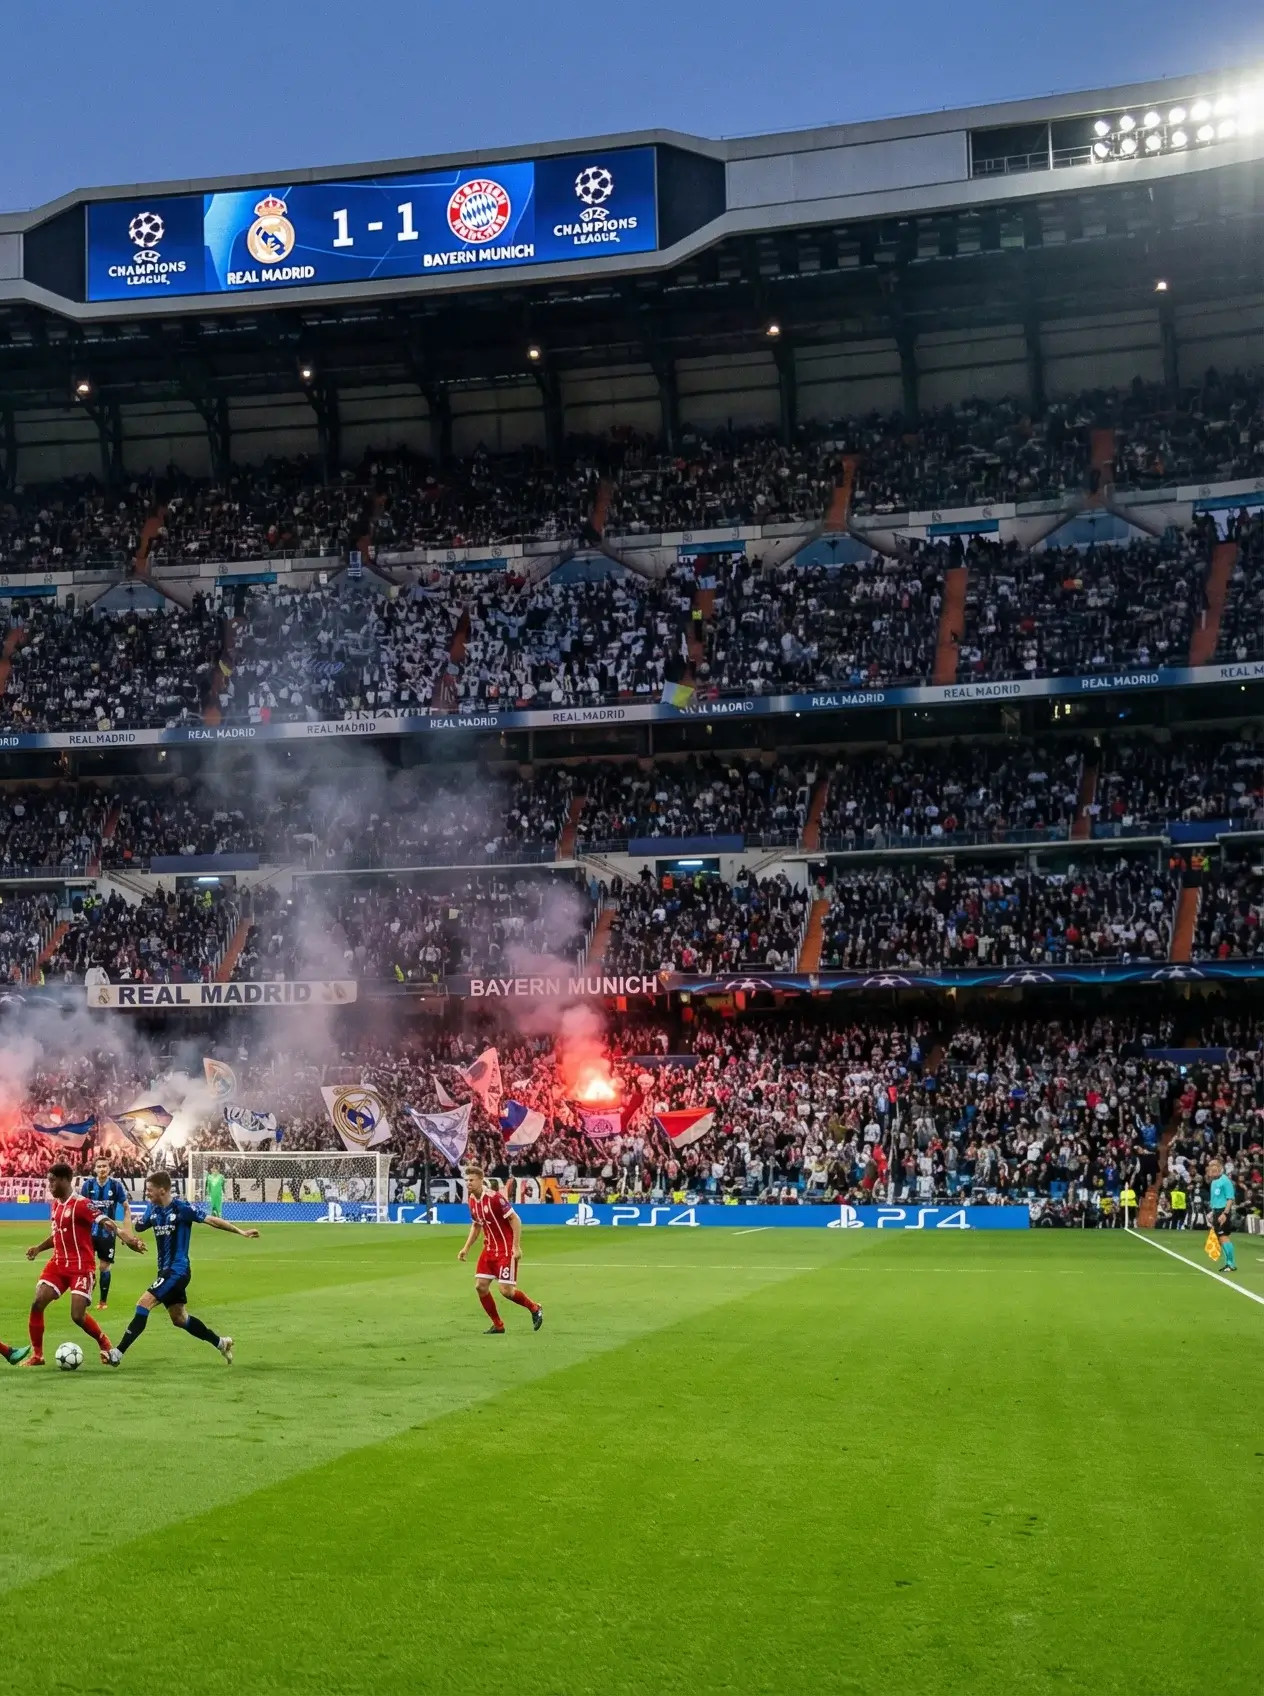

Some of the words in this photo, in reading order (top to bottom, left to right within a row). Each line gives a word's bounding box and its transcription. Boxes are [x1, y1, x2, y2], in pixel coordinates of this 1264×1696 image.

[333, 208, 353, 247] 1
[368, 221, 383, 231] -
[397, 201, 418, 241] 1
[553, 217, 638, 236] CHAMPIONS
[423, 249, 476, 267] BAYERN
[479, 244, 534, 262] MUNICH
[108, 261, 186, 277] CHAMPIONS
[227, 270, 259, 285] REAL
[262, 265, 315, 281] MADRID
[1081, 678, 1111, 690] REAL
[1113, 673, 1159, 687] MADRID
[944, 687, 972, 698] REAL
[975, 684, 1021, 697] MADRID
[812, 697, 839, 707] REAL
[552, 712, 579, 722] REAL
[582, 709, 625, 720] MADRID
[69, 734, 94, 744] REAL
[96, 733, 136, 743] MADRID
[188, 730, 214, 739] REAL
[216, 728, 256, 738] MADRID
[307, 725, 333, 735] REAL
[118, 986, 190, 1005] REAL
[200, 984, 311, 1004] MADRID
[470, 978, 560, 997] BAYERN
[568, 976, 657, 995] MUNICH
[612, 1206, 700, 1226] PS4
[877, 1208, 971, 1229] PS4
